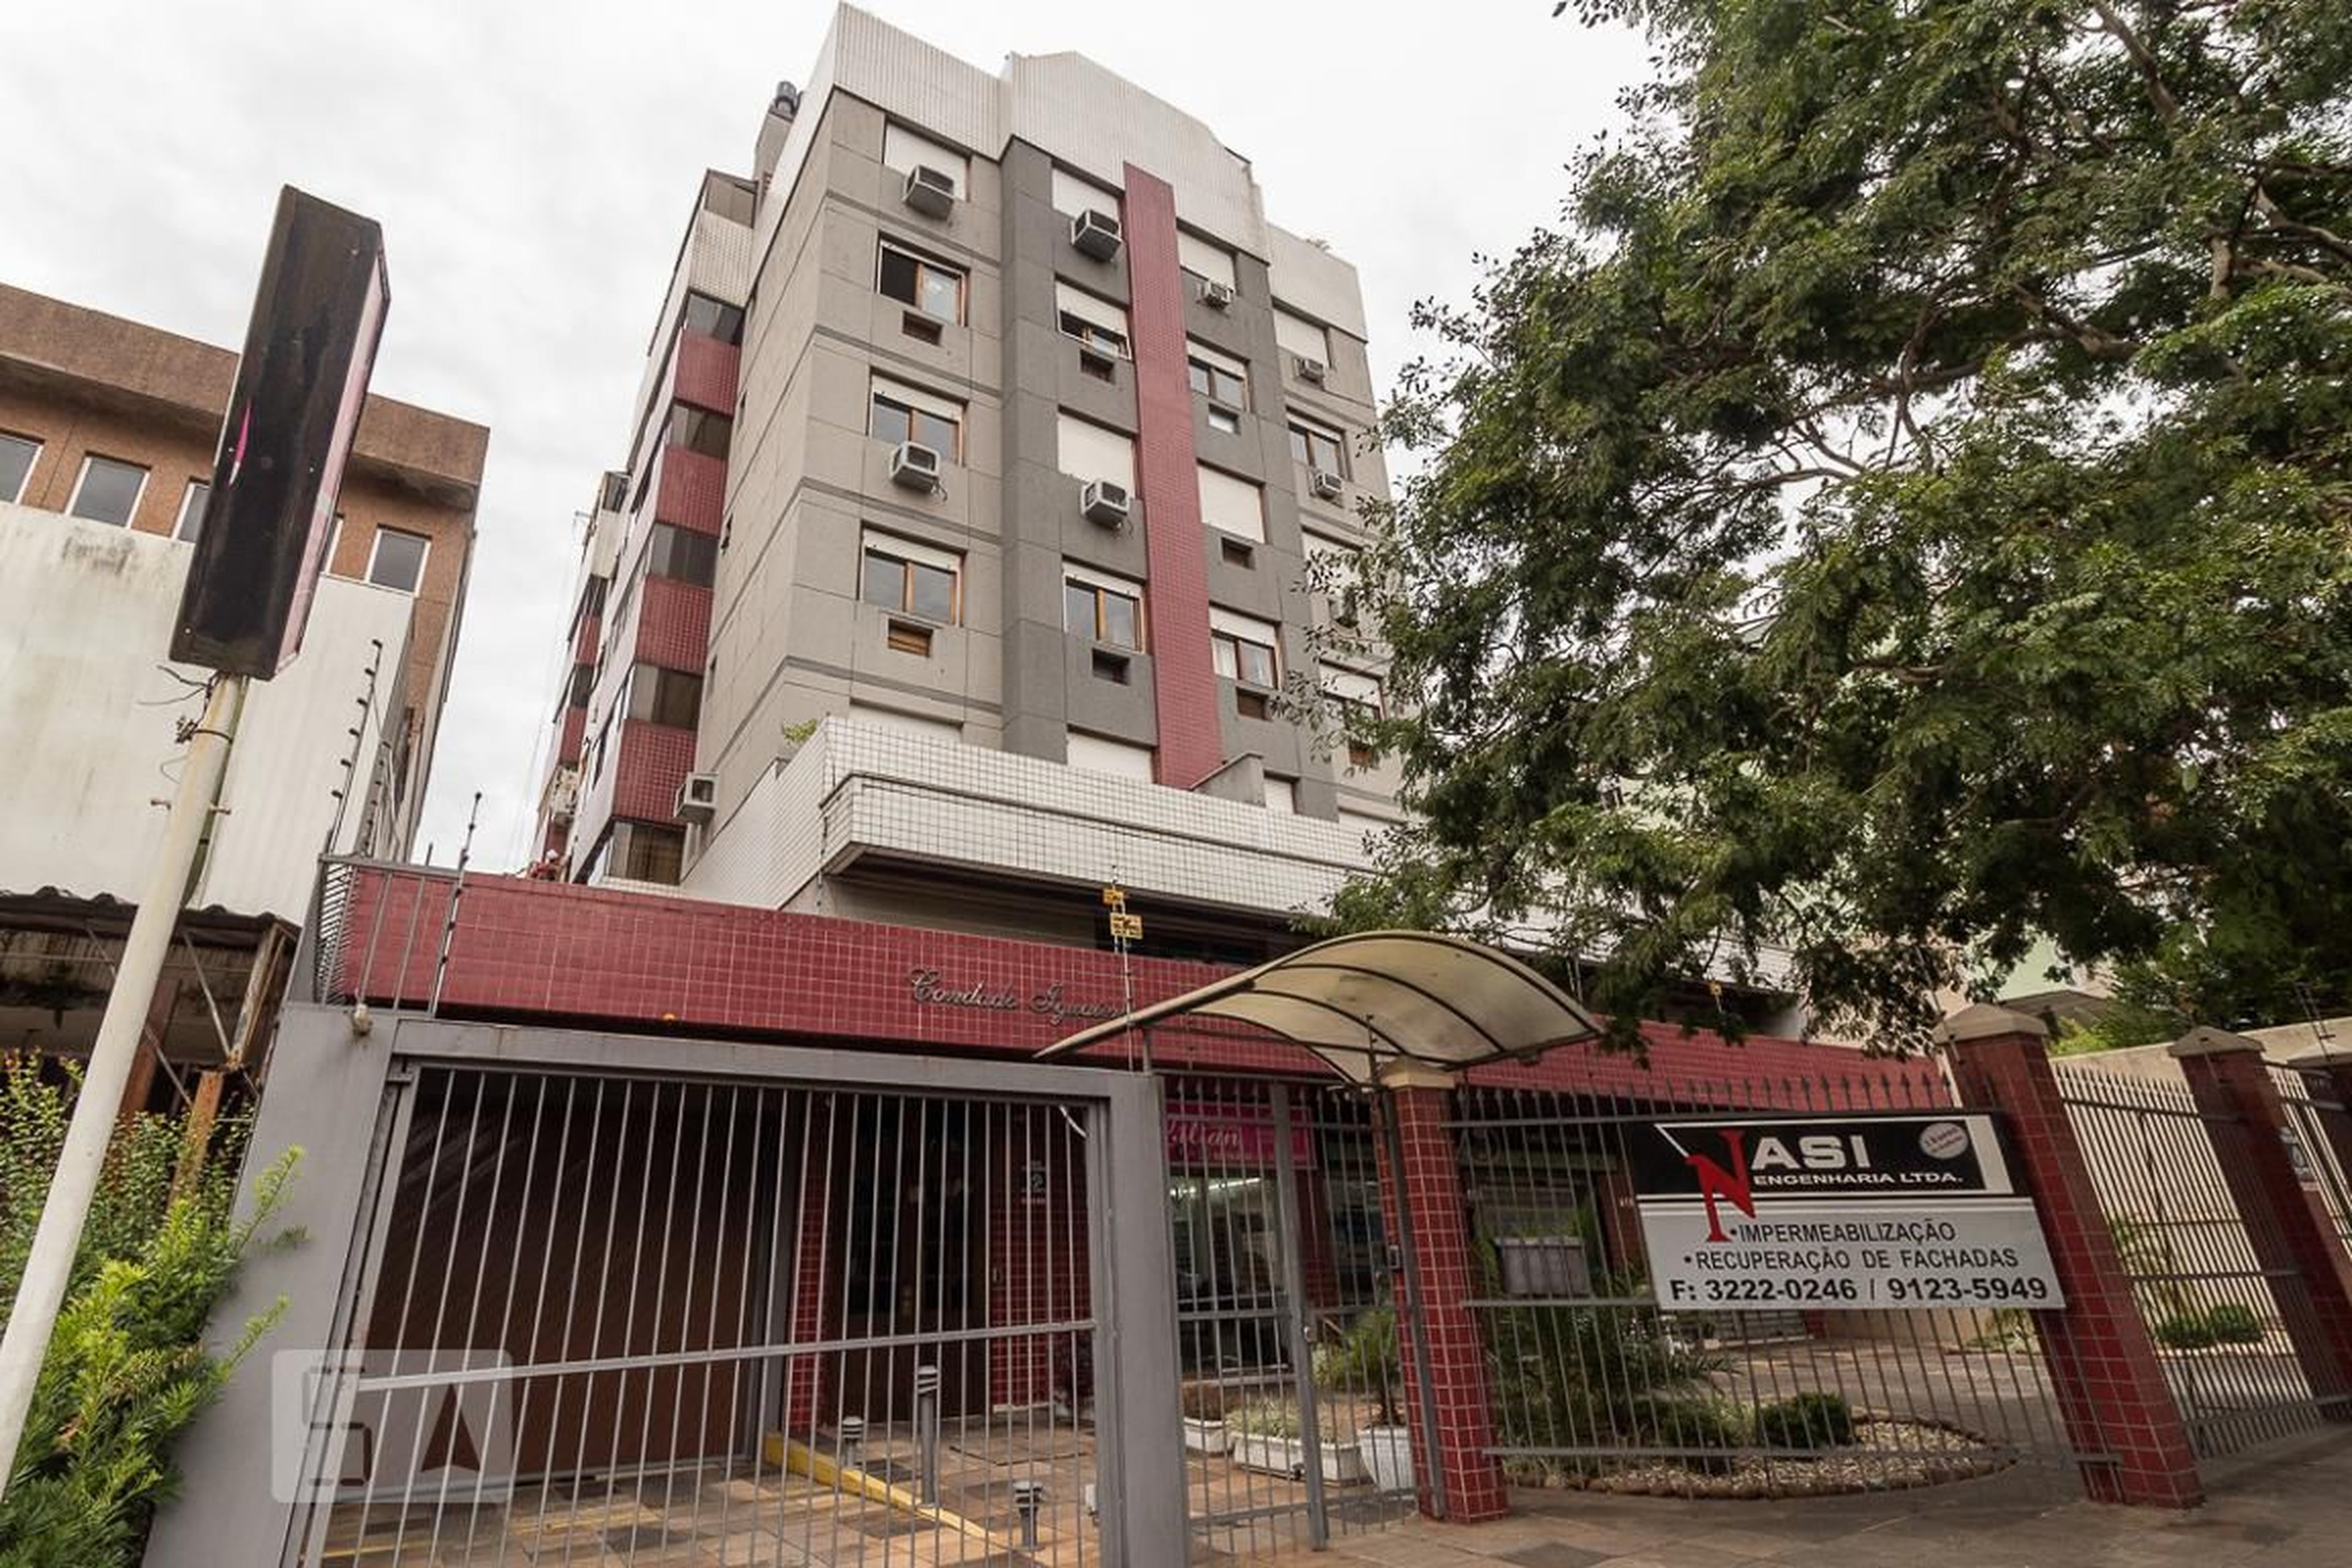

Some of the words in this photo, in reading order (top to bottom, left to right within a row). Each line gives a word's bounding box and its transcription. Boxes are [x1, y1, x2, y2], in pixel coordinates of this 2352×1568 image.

[1687, 1129, 1871, 1242] NASI
[1754, 1173, 1895, 1186] ENGENHARIA
[1899, 1171, 1964, 1183] LTDA.
[1738, 1218, 1956, 1245] IMPERMEABILIZAÇÃO
[1695, 1246, 1850, 1274] RECUPERAÇÃO
[1861, 1250, 1891, 1268] DE
[1900, 1248, 2019, 1268] FACHADAS
[1670, 1279, 1697, 1300] F:
[1705, 1278, 1858, 1300] 3222-0246
[1887, 1278, 2048, 1300] 9123-5949
